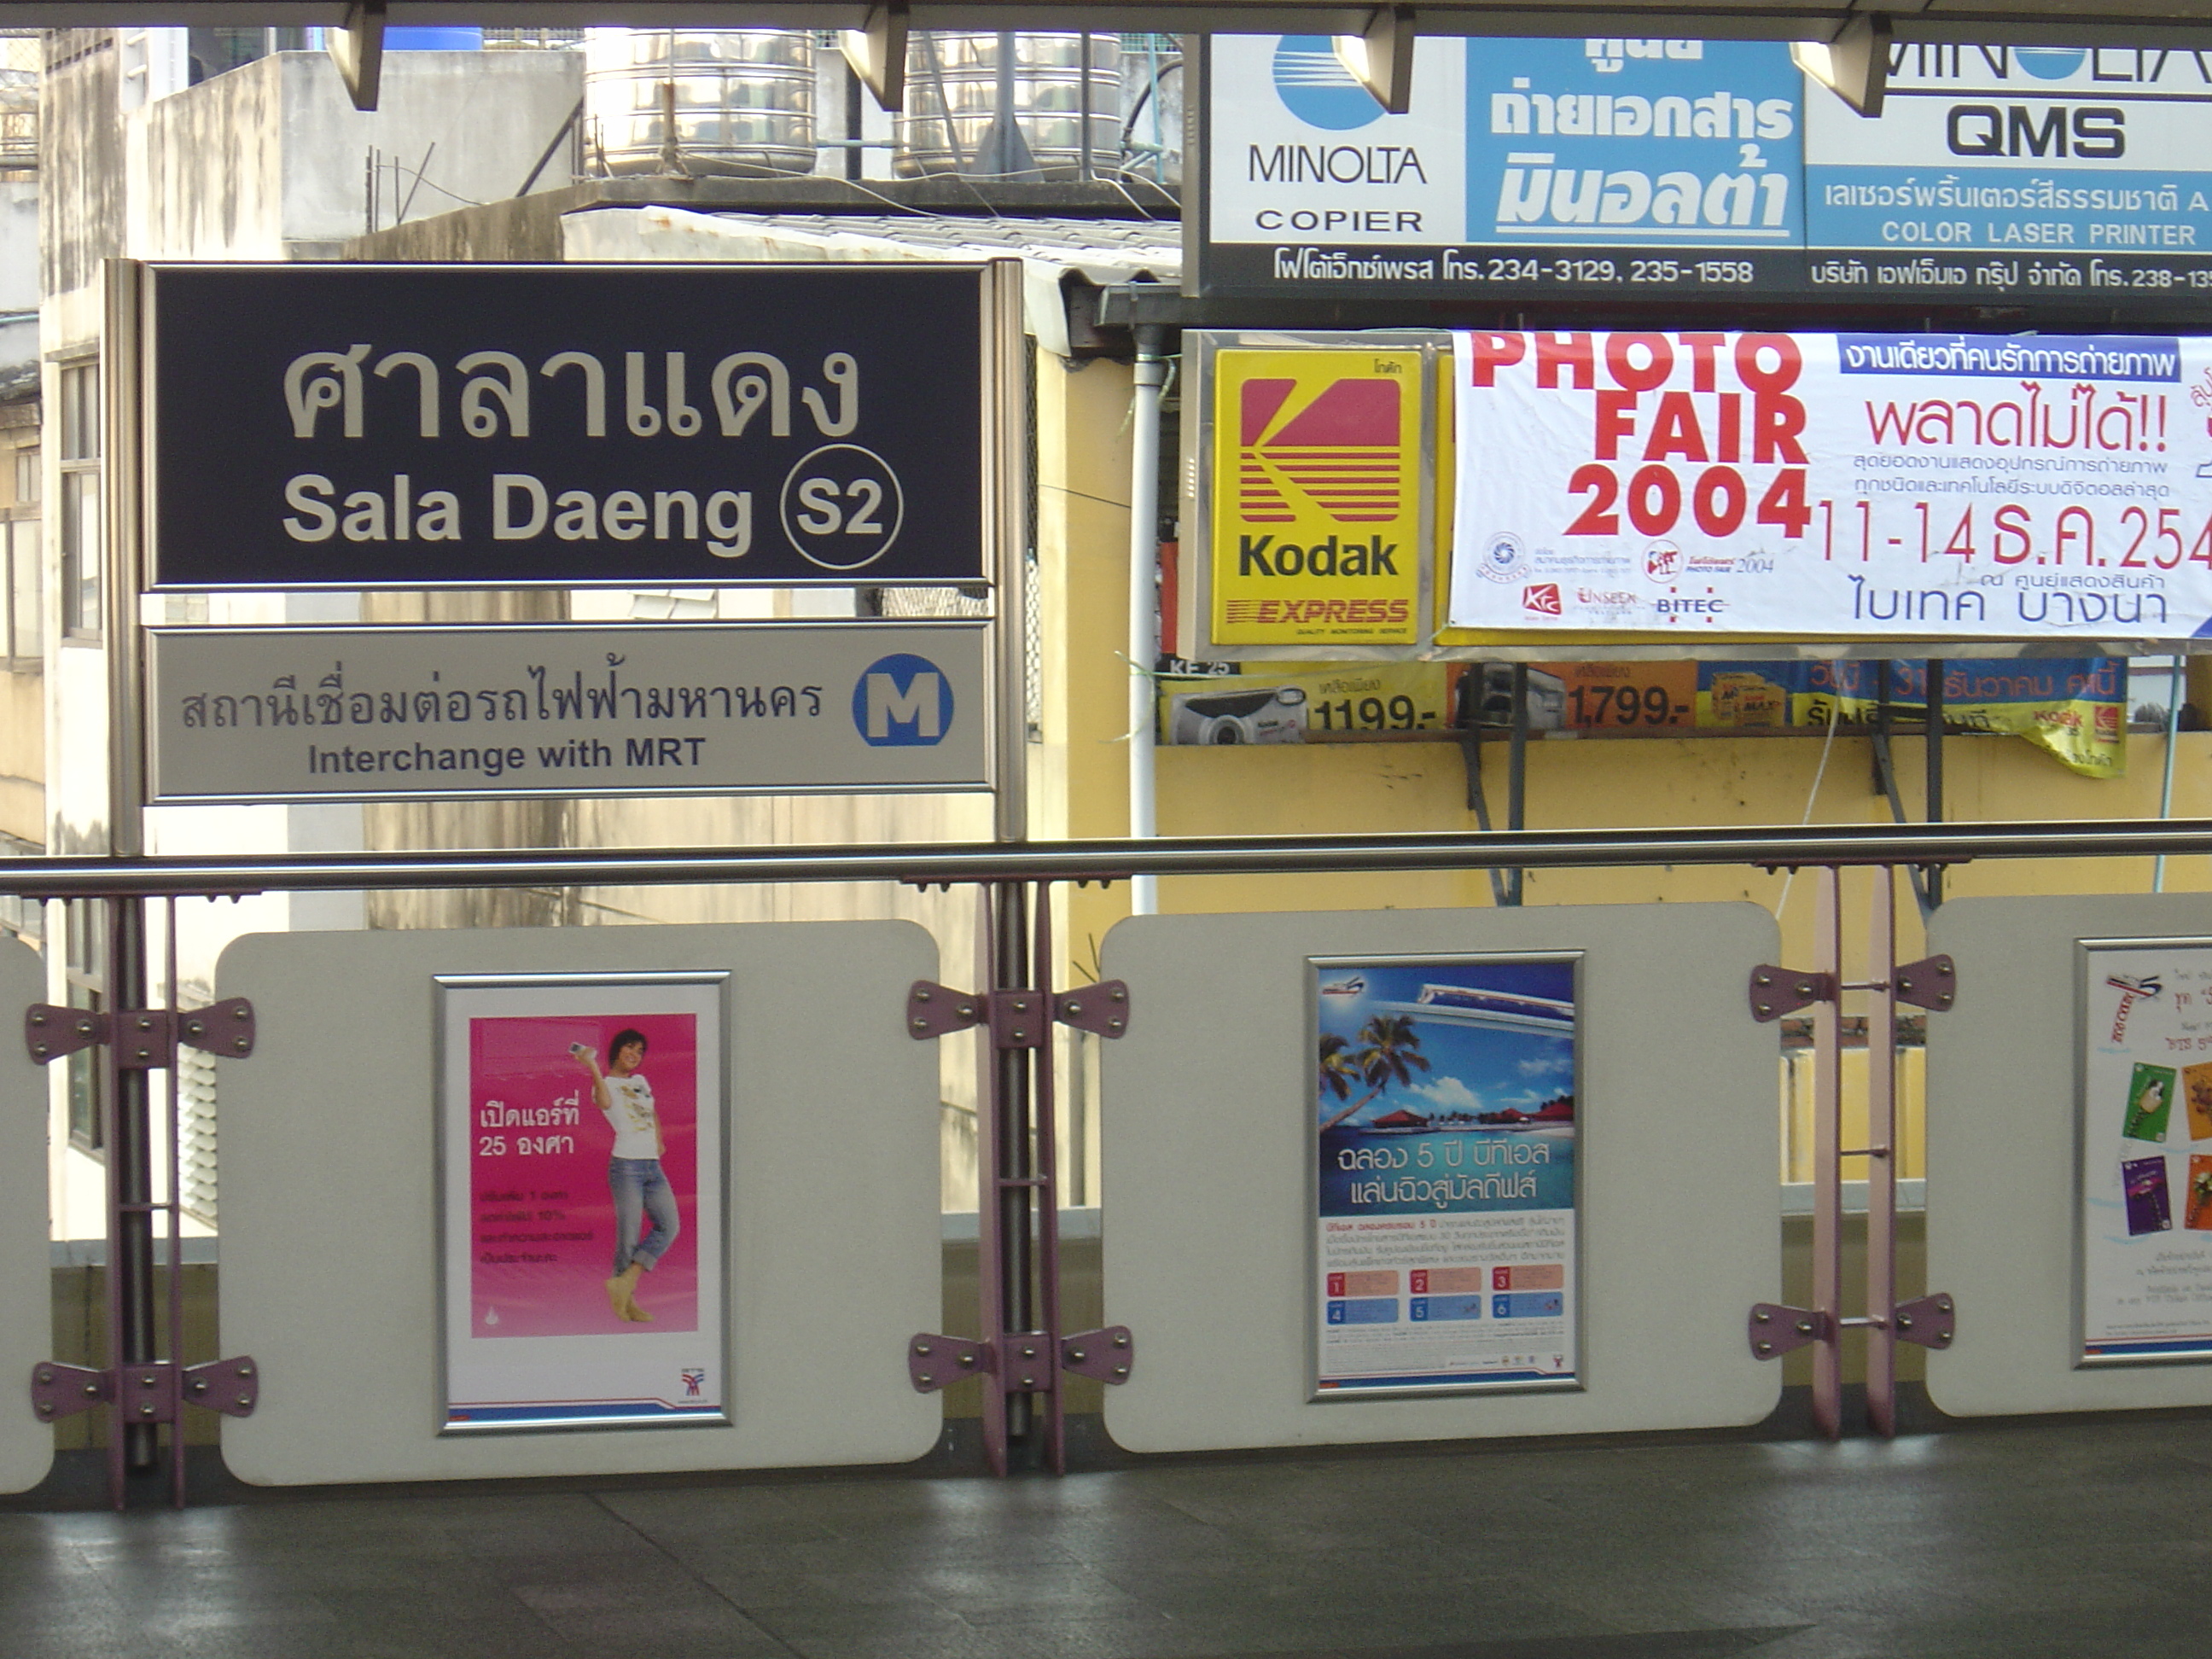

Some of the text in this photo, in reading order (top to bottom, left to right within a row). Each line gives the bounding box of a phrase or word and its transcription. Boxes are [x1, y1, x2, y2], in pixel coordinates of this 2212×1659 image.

[1491, 77, 1794, 139] ถ่ายเอกสาร
[1947, 104, 2126, 159] QMS
[1249, 144, 1427, 184] MINOLTA
[1496, 143, 1790, 226] มินอลต้า
[1255, 209, 1423, 232] COPIER
[1882, 220, 2196, 246] COLOR LASER PRINTER
[1631, 261, 1754, 283] 235-1558
[1811, 259, 1869, 284] บริษัท
[2028, 261, 2082, 287] จำกัด
[1470, 331, 1802, 393] PHOTO
[1845, 335, 2175, 377] งานเดียวที่คนรักการถ่ายภาพ
[282, 343, 859, 439] ศาลาแดง
[1595, 389, 1810, 465] FAIR
[1866, 381, 2167, 452] พลาดไม่ได้!!
[282, 473, 884, 559] Sala Daeng S2
[1563, 463, 1812, 539] 2004
[1239, 534, 1399, 577] Kodak
[1736, 557, 1775, 573] 2004
[1256, 599, 1409, 623] EXPRESS
[1656, 597, 1725, 613] BITEC
[1848, 573, 2168, 624] ไบเทค บางนา
[182, 652, 823, 728] สถานีเชื่อมต่อรถไฟฟ้ามหานคร
[309, 737, 707, 777] Interchange with MRT
[480, 1089, 579, 1128] เปิดแอร์ที่
[479, 1134, 574, 1156] 25 องศา
[1337, 1138, 1551, 1170] ฉลอง 5 ปี บีทีเอส
[1416, 1280, 1424, 1291] 2
[1499, 1277, 1507, 1288] 3
[1416, 1306, 1424, 1318] 5
